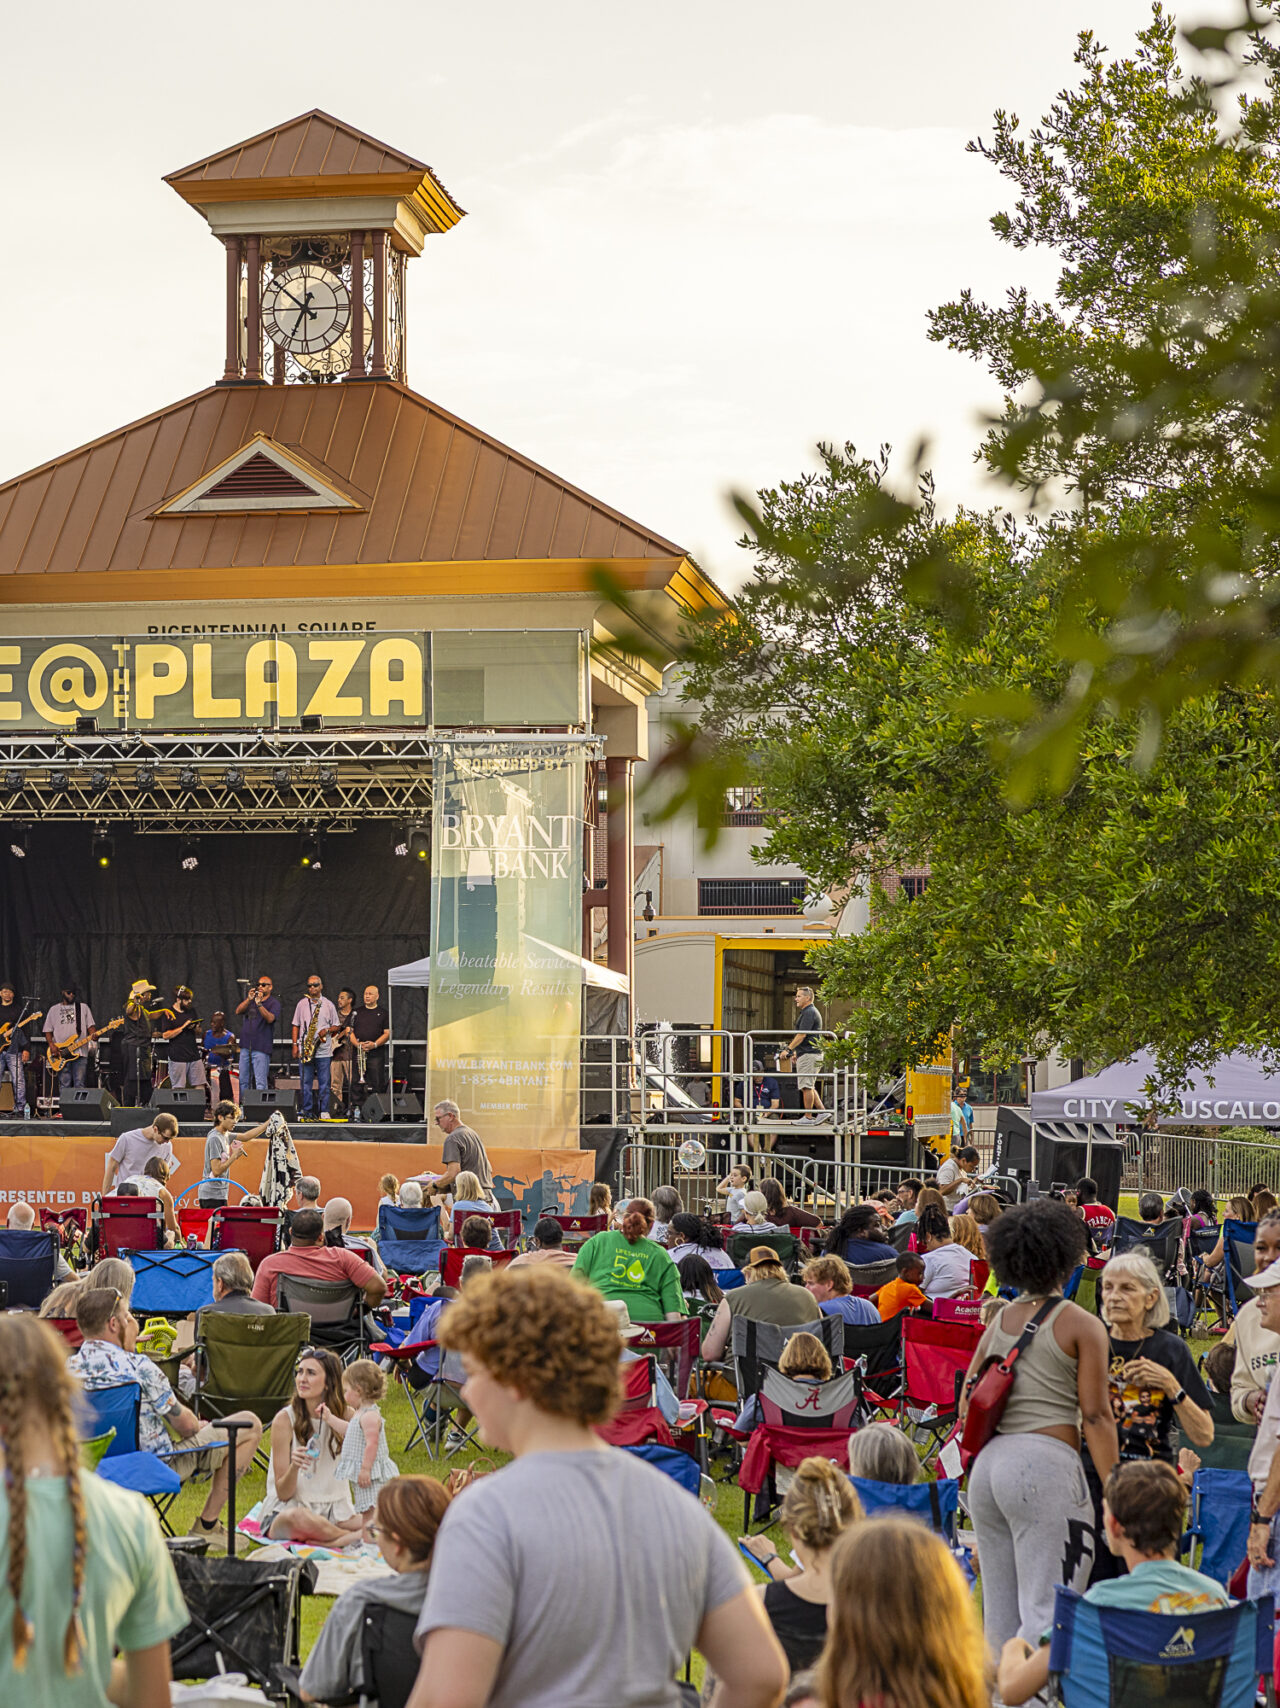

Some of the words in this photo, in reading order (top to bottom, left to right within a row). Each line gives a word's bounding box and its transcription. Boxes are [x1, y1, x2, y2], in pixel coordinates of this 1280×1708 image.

[147, 623, 288, 641] BICENTENNIAL
[297, 621, 378, 638] SQUARE
[112, 644, 131, 718] THE
[134, 638, 423, 720] PLAZA
[453, 758, 539, 771] SPONSORED
[544, 758, 565, 770] BY
[441, 814, 575, 848] BRYANT
[494, 851, 568, 879] BANK
[437, 951, 519, 969] Unbeatable
[524, 951, 577, 969] Service.
[437, 977, 514, 1000] Legendary
[520, 977, 575, 996] Results.
[436, 1058, 573, 1073] WWW.BRYANTBANK.COM
[460, 1073, 549, 1087] 1-855-4BRYANT
[480, 1102, 510, 1110] MEMBER
[1063, 1099, 1117, 1118] CITY
[1168, 1100, 1280, 1120] USCALO
[82, 1191, 102, 1204] BY
[1087, 1215, 1114, 1227] FRANCI
[1251, 1352, 1280, 1371] ESSE
